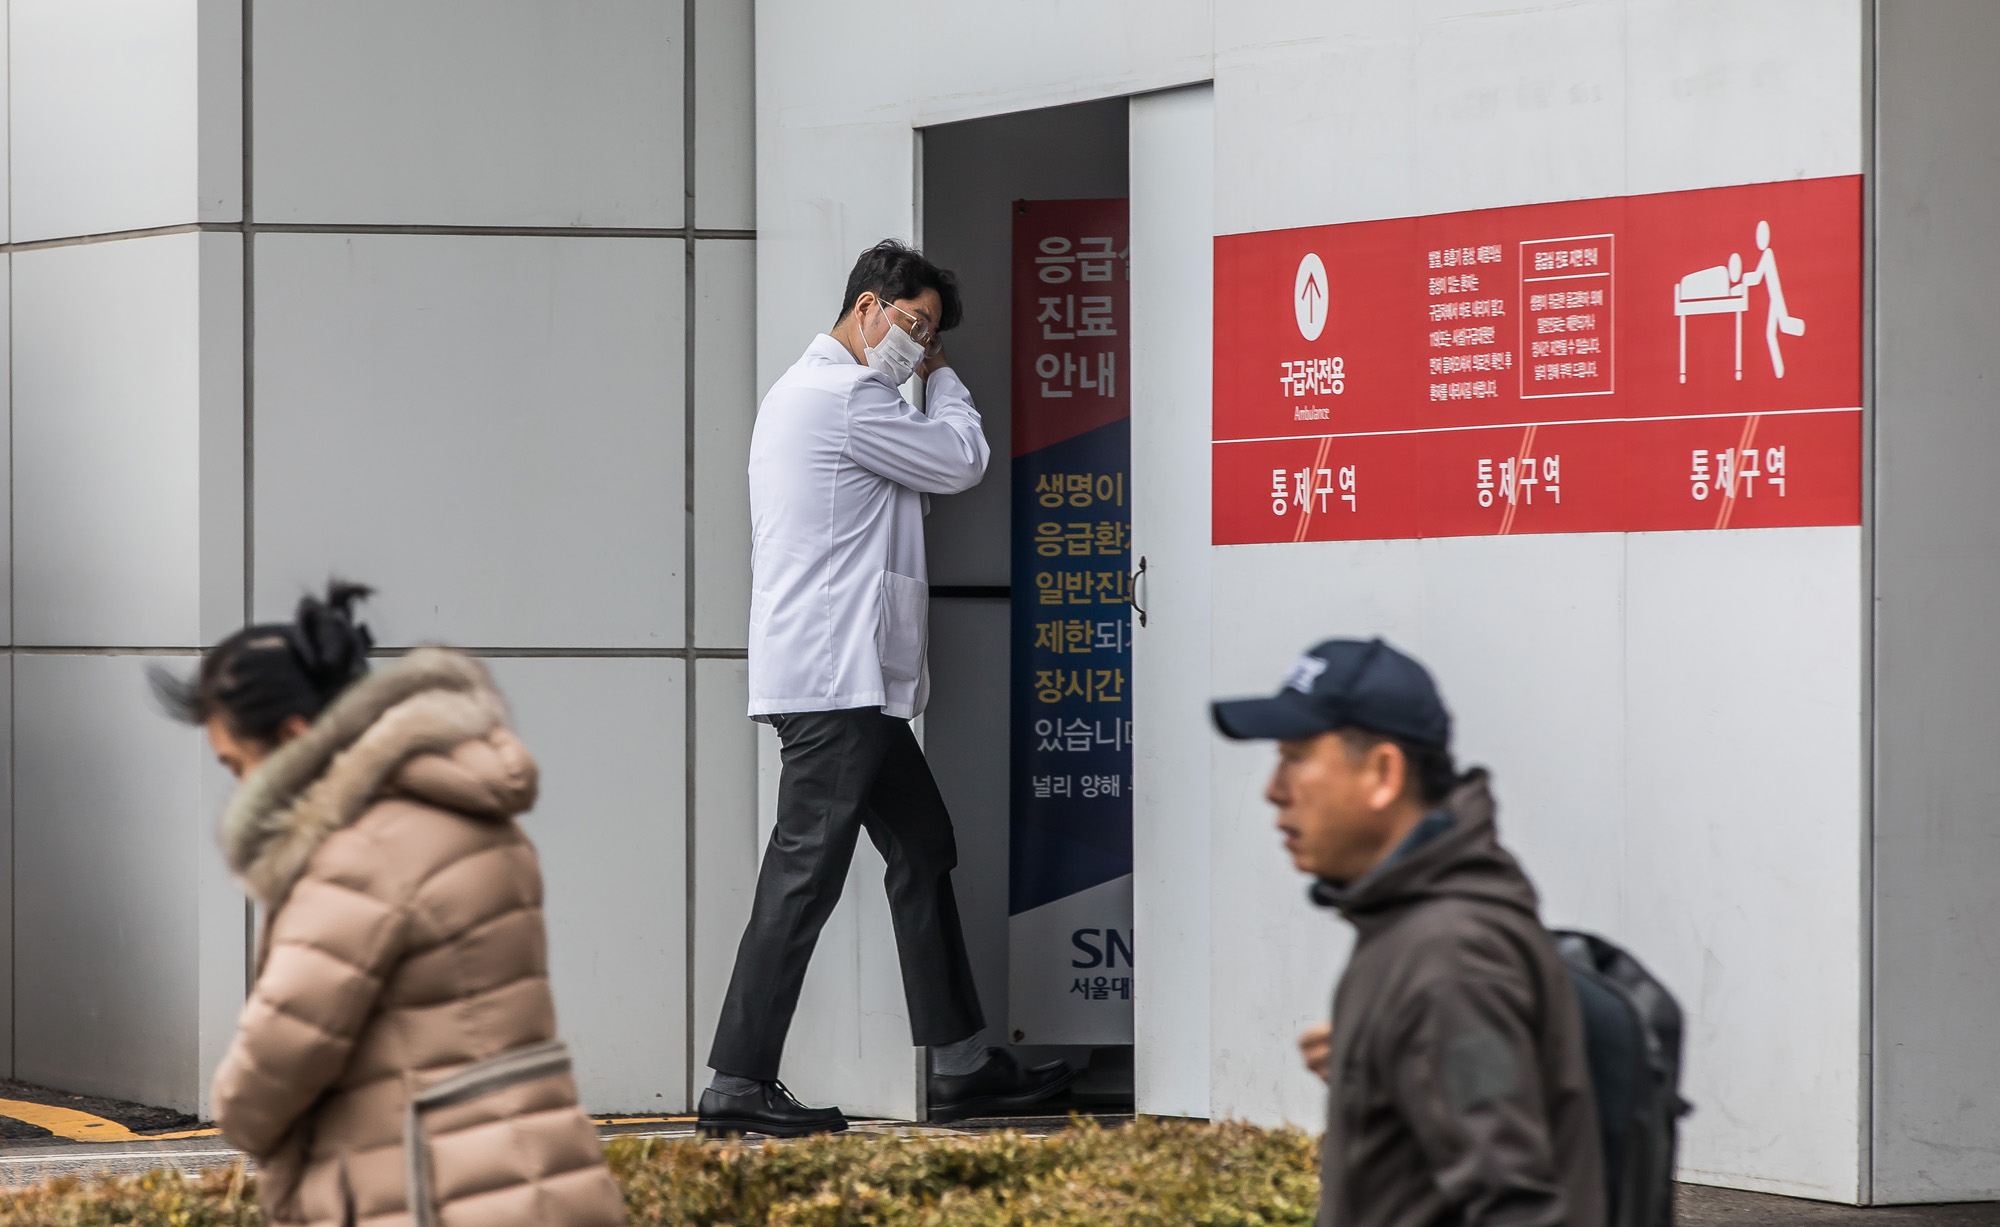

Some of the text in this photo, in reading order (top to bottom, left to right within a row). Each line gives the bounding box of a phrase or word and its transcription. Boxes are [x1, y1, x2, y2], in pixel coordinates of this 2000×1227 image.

[1535, 251, 1554, 271] 응급실
[1556, 251, 1568, 268] 진료
[1584, 248, 1598, 266] 안내
[1037, 294, 1117, 340] 진료
[1505, 351, 1512, 369] 후
[1568, 339, 1576, 355] 수
[1036, 351, 1115, 397] 안내
[1280, 356, 1346, 398] 구급차전용
[1294, 404, 1331, 421] Ambulance
[1035, 472, 1123, 508] 생명이
[1270, 463, 1357, 517] 통제구역
[1476, 453, 1561, 508] 통제구역
[1690, 445, 1786, 501] 통제구역
[1035, 619, 1131, 654] 제한되
[1035, 668, 1125, 703] 장시간
[1032, 775, 1072, 798] 널리
[1080, 774, 1120, 798] 양해
[1071, 928, 1134, 969] SN
[1069, 976, 1134, 1000] 서울대
